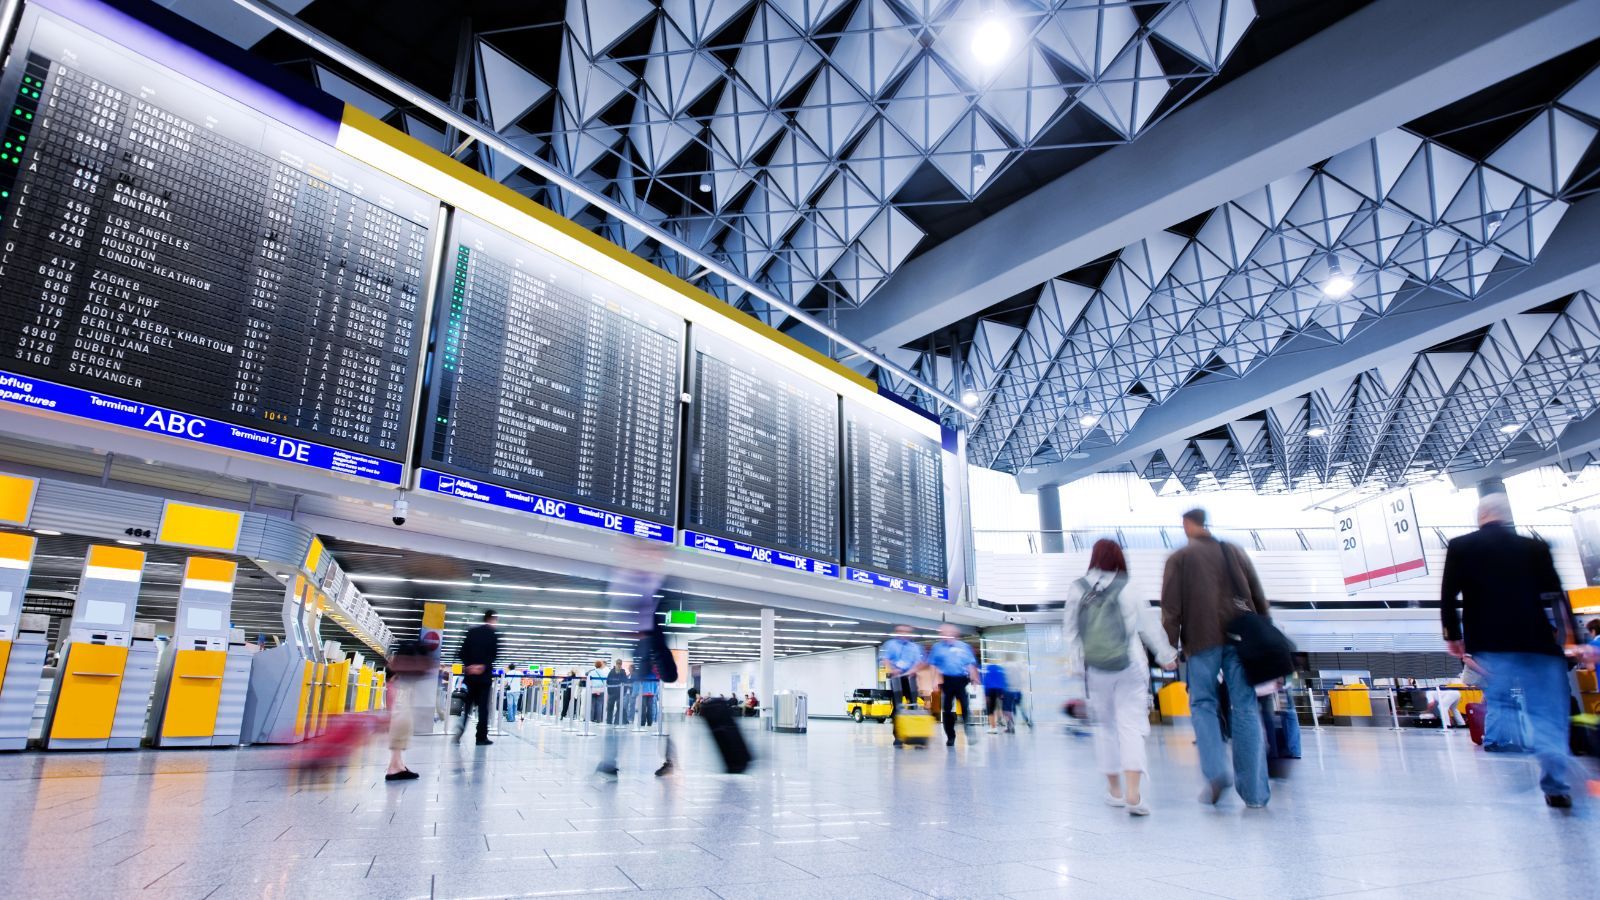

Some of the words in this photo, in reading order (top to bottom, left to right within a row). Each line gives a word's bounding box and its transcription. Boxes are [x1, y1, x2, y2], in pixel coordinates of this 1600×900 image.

[88, 90, 119, 110] 3102
[134, 111, 190, 141] HELSINKI
[137, 100, 194, 132] VARADERO
[90, 114, 113, 131] 462
[129, 130, 165, 152] MIAMI
[132, 120, 190, 152] PORTLAND
[72, 178, 96, 194] 875
[112, 192, 172, 222] MONTREAL
[76, 167, 99, 183] 494
[115, 182, 168, 209] CALGARY
[60, 222, 84, 237] 440
[101, 236, 156, 261] HOUSTON
[63, 211, 88, 226] 442
[104, 225, 158, 250] DETROIT
[107, 214, 130, 229] LOS
[138, 225, 190, 250] ANGELES
[48, 230, 81, 249] 4726
[98, 247, 210, 291] LONDON-HEATHROW
[50, 256, 75, 272] 417
[92, 269, 140, 292] ZAGREB
[38, 265, 72, 282] 6808
[89, 281, 130, 300] KOELN
[137, 295, 160, 309] HBF
[35, 315, 60, 329] 117
[77, 326, 150, 353] LJUBLJANA
[40, 291, 66, 306] 590
[83, 303, 124, 323] ADDIS
[131, 317, 233, 354] ABEBA-KHARTOUM
[338, 377, 376, 394] 050-468
[386, 391, 401, 402] B23
[44, 279, 69, 294] 686
[87, 292, 110, 306] TEL
[118, 302, 151, 318] AVIV
[339, 368, 377, 385] 050-468
[38, 303, 63, 318] 176
[80, 315, 174, 348] BERLIN-TEGEL
[336, 387, 374, 404] 050-468
[384, 401, 400, 411] A13
[0, 376, 33, 392] bflug
[18, 336, 53, 353] 3126
[71, 350, 121, 370] BERGEN
[331, 417, 370, 433] 050-468
[380, 429, 391, 438] B1
[22, 324, 56, 341] 4980
[74, 338, 124, 359] DUBLIN
[333, 407, 371, 423] 050-468
[382, 420, 397, 430] B32
[501, 381, 530, 396] DETROIT
[502, 373, 531, 389] CHICAGO
[0, 388, 56, 408] epartures
[14, 349, 50, 365] 3160
[68, 362, 142, 388] STAVANGER
[330, 427, 368, 443] 050-468
[379, 439, 395, 449] B13
[500, 390, 521, 402] PARIS
[90, 395, 137, 414] Terminal
[138, 406, 144, 415] 1
[144, 410, 206, 438] ABC
[230, 428, 270, 443] Terminal
[278, 440, 310, 462] DE
[496, 432, 526, 446] TORONTO
[497, 423, 526, 438] VILNIUS
[494, 449, 532, 466] AMSTERDAM
[495, 441, 528, 456] HELSINKI
[492, 467, 518, 480] DUBLIN
[493, 458, 543, 477] POZNAN/POSEN
[455, 488, 490, 501] Departures
[456, 480, 478, 491] Abflug
[505, 490, 530, 502] Terminal
[534, 499, 566, 518] ABC
[578, 507, 600, 518] Terminal
[604, 514, 622, 530] DE
[1390, 499, 1404, 514] 10
[125, 528, 151, 538] 464
[1340, 518, 1352, 532] 20
[1394, 519, 1408, 534] 10
[752, 548, 772, 562] ABC
[795, 557, 806, 570] DE
[1343, 537, 1356, 551] 20
[890, 578, 903, 589] ABC
